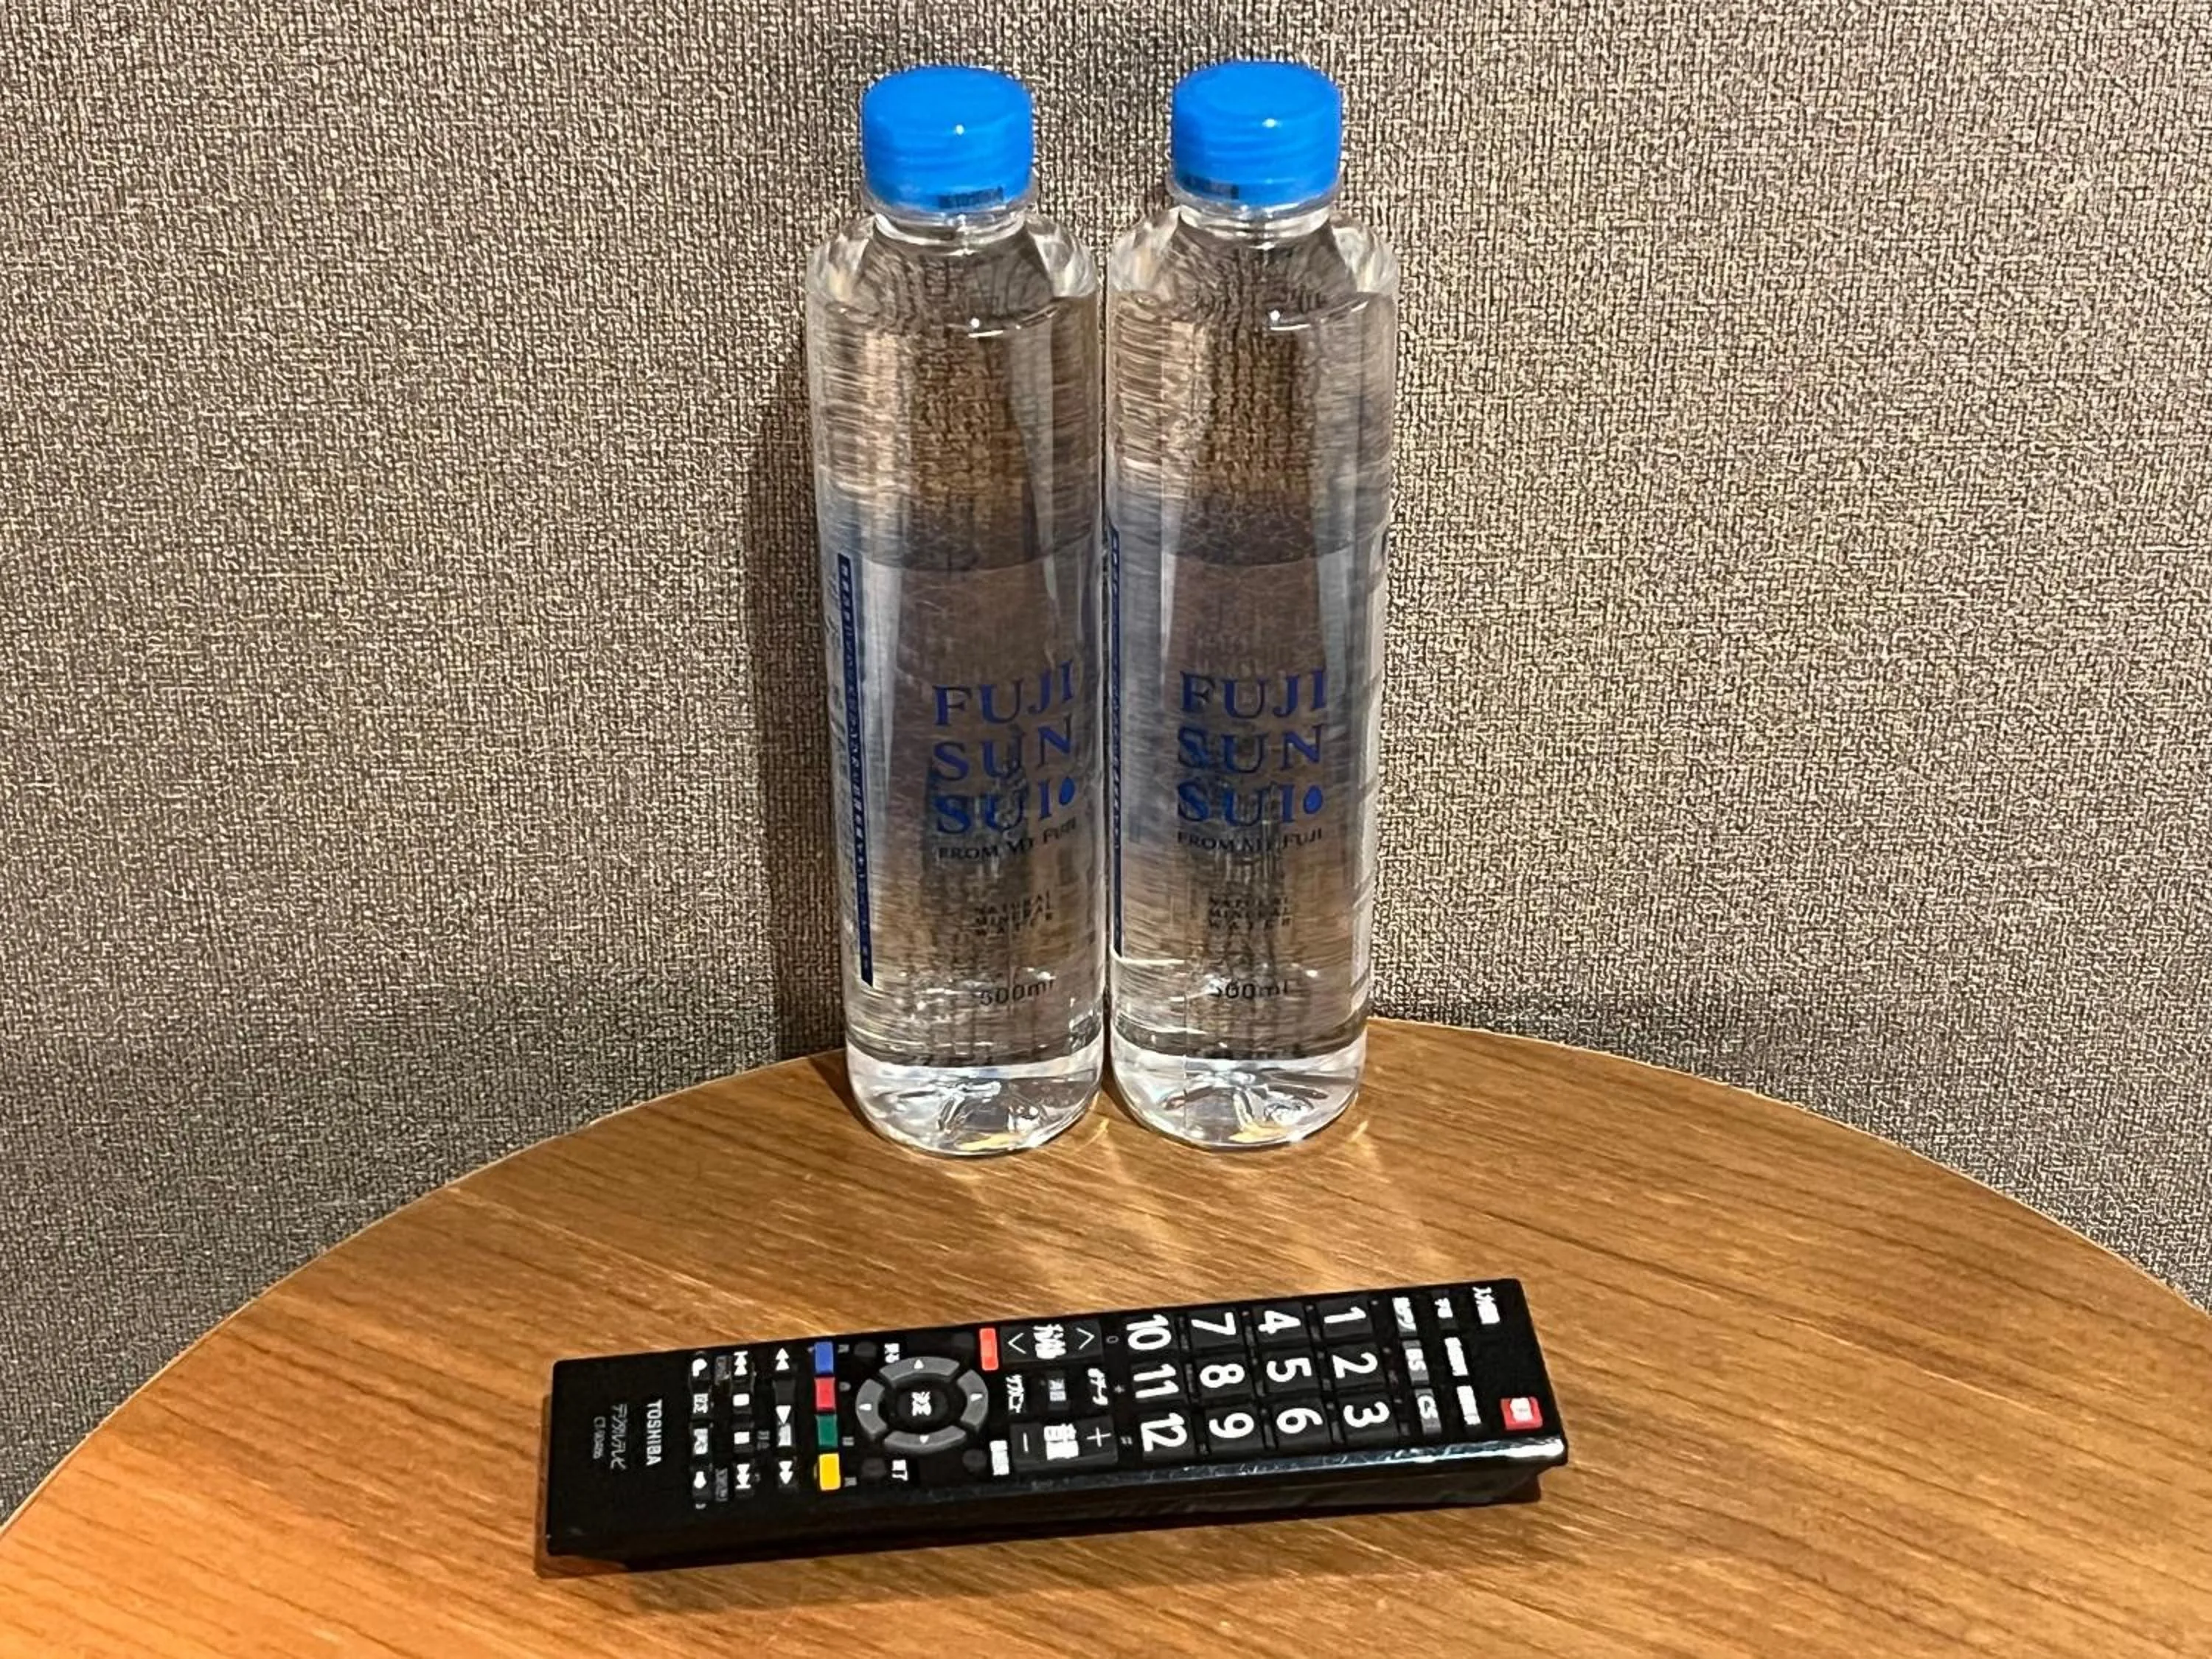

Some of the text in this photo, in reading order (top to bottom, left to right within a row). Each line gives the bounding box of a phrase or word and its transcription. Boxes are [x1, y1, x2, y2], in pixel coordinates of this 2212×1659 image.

[932, 660, 1073, 726] FUJI
[1180, 668, 1326, 718] FUJI
[933, 713, 1072, 782] SUN
[1178, 723, 1324, 773] SUN
[932, 778, 1052, 835] SUI
[1178, 781, 1295, 827] SUI
[1178, 830, 1234, 852] FROM
[1280, 827, 1322, 849] FUJI
[1191, 1312, 1237, 1336] 7
[1258, 1310, 1301, 1335] 4
[1324, 1306, 1367, 1324] 1
[1126, 1314, 1172, 1351] 10
[1266, 1357, 1312, 1382] 5
[1332, 1352, 1378, 1379] 2
[1405, 1348, 1427, 1371] BS
[1133, 1363, 1180, 1399] 11
[1199, 1363, 1245, 1388] 8
[1343, 1401, 1390, 1428] 3
[1417, 1395, 1439, 1419] CS
[646, 1399, 662, 1466] TOSHIBA
[1140, 1412, 1188, 1453] 12
[1208, 1412, 1255, 1439] 9
[1276, 1408, 1324, 1434] 6
